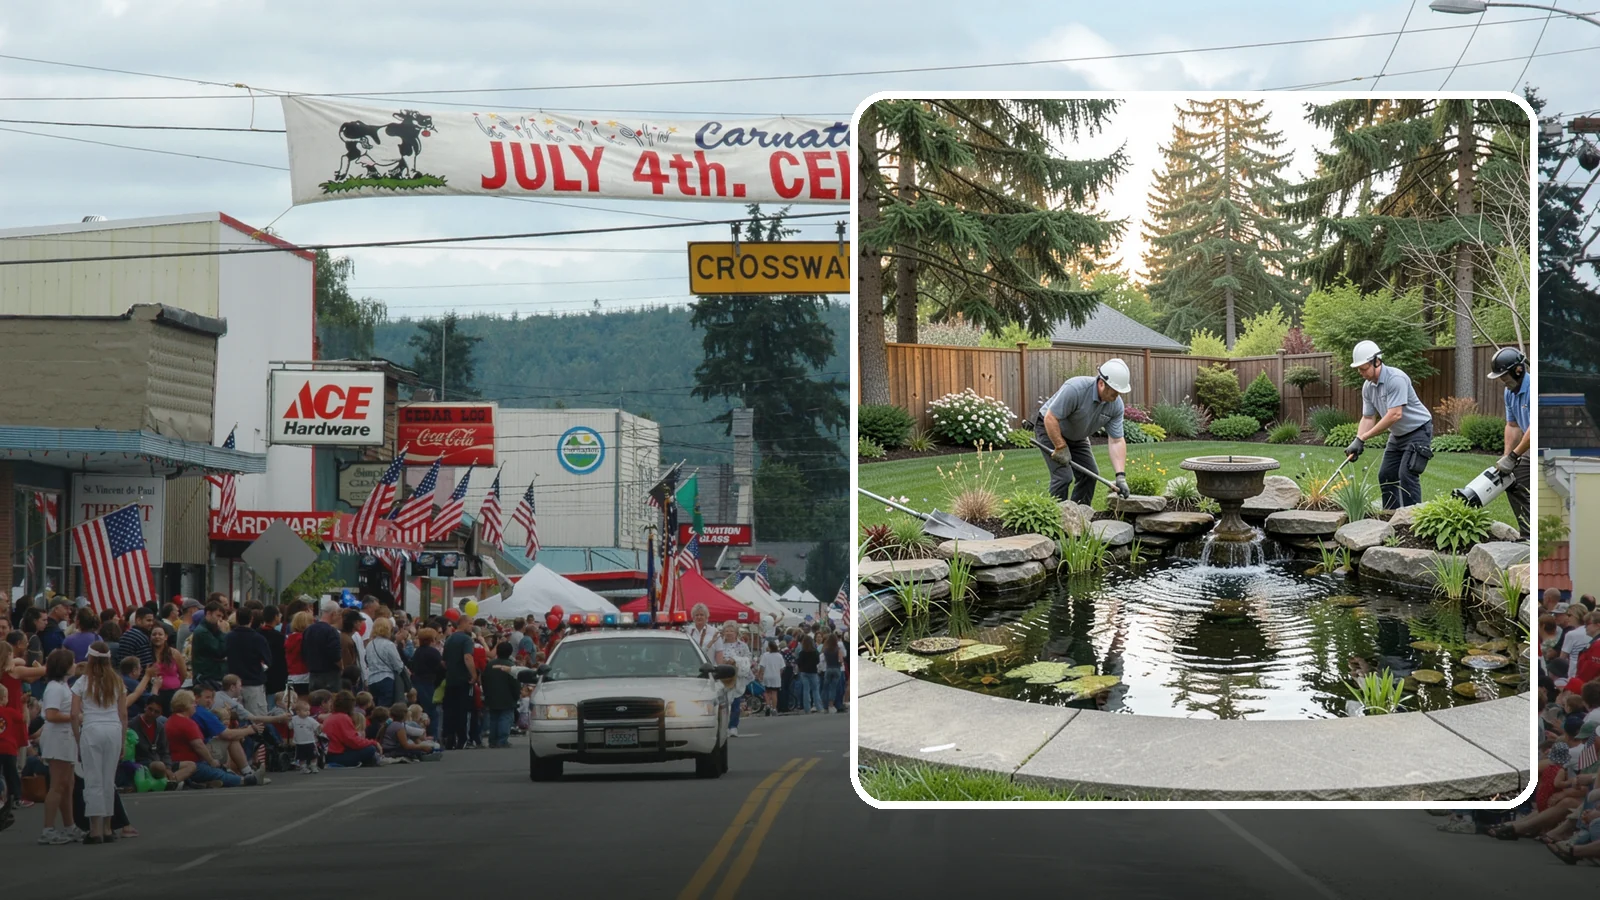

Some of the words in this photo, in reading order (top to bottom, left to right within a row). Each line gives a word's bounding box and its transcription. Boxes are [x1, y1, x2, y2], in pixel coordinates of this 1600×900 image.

[481, 141, 604, 192] JULY
[632, 150, 746, 198] 4th.
[696, 254, 850, 280] CROSSWA
[283, 380, 373, 420] ACE
[405, 409, 452, 422] CEDAR
[461, 409, 485, 422] LOG
[283, 421, 371, 436] Hardware
[416, 428, 477, 447] Coca-Cola
[95, 485, 124, 495] Vincent
[126, 486, 135, 495] de
[137, 486, 155, 495] Paul
[688, 526, 741, 535] CRNATION
[699, 535, 730, 543] GLASS
